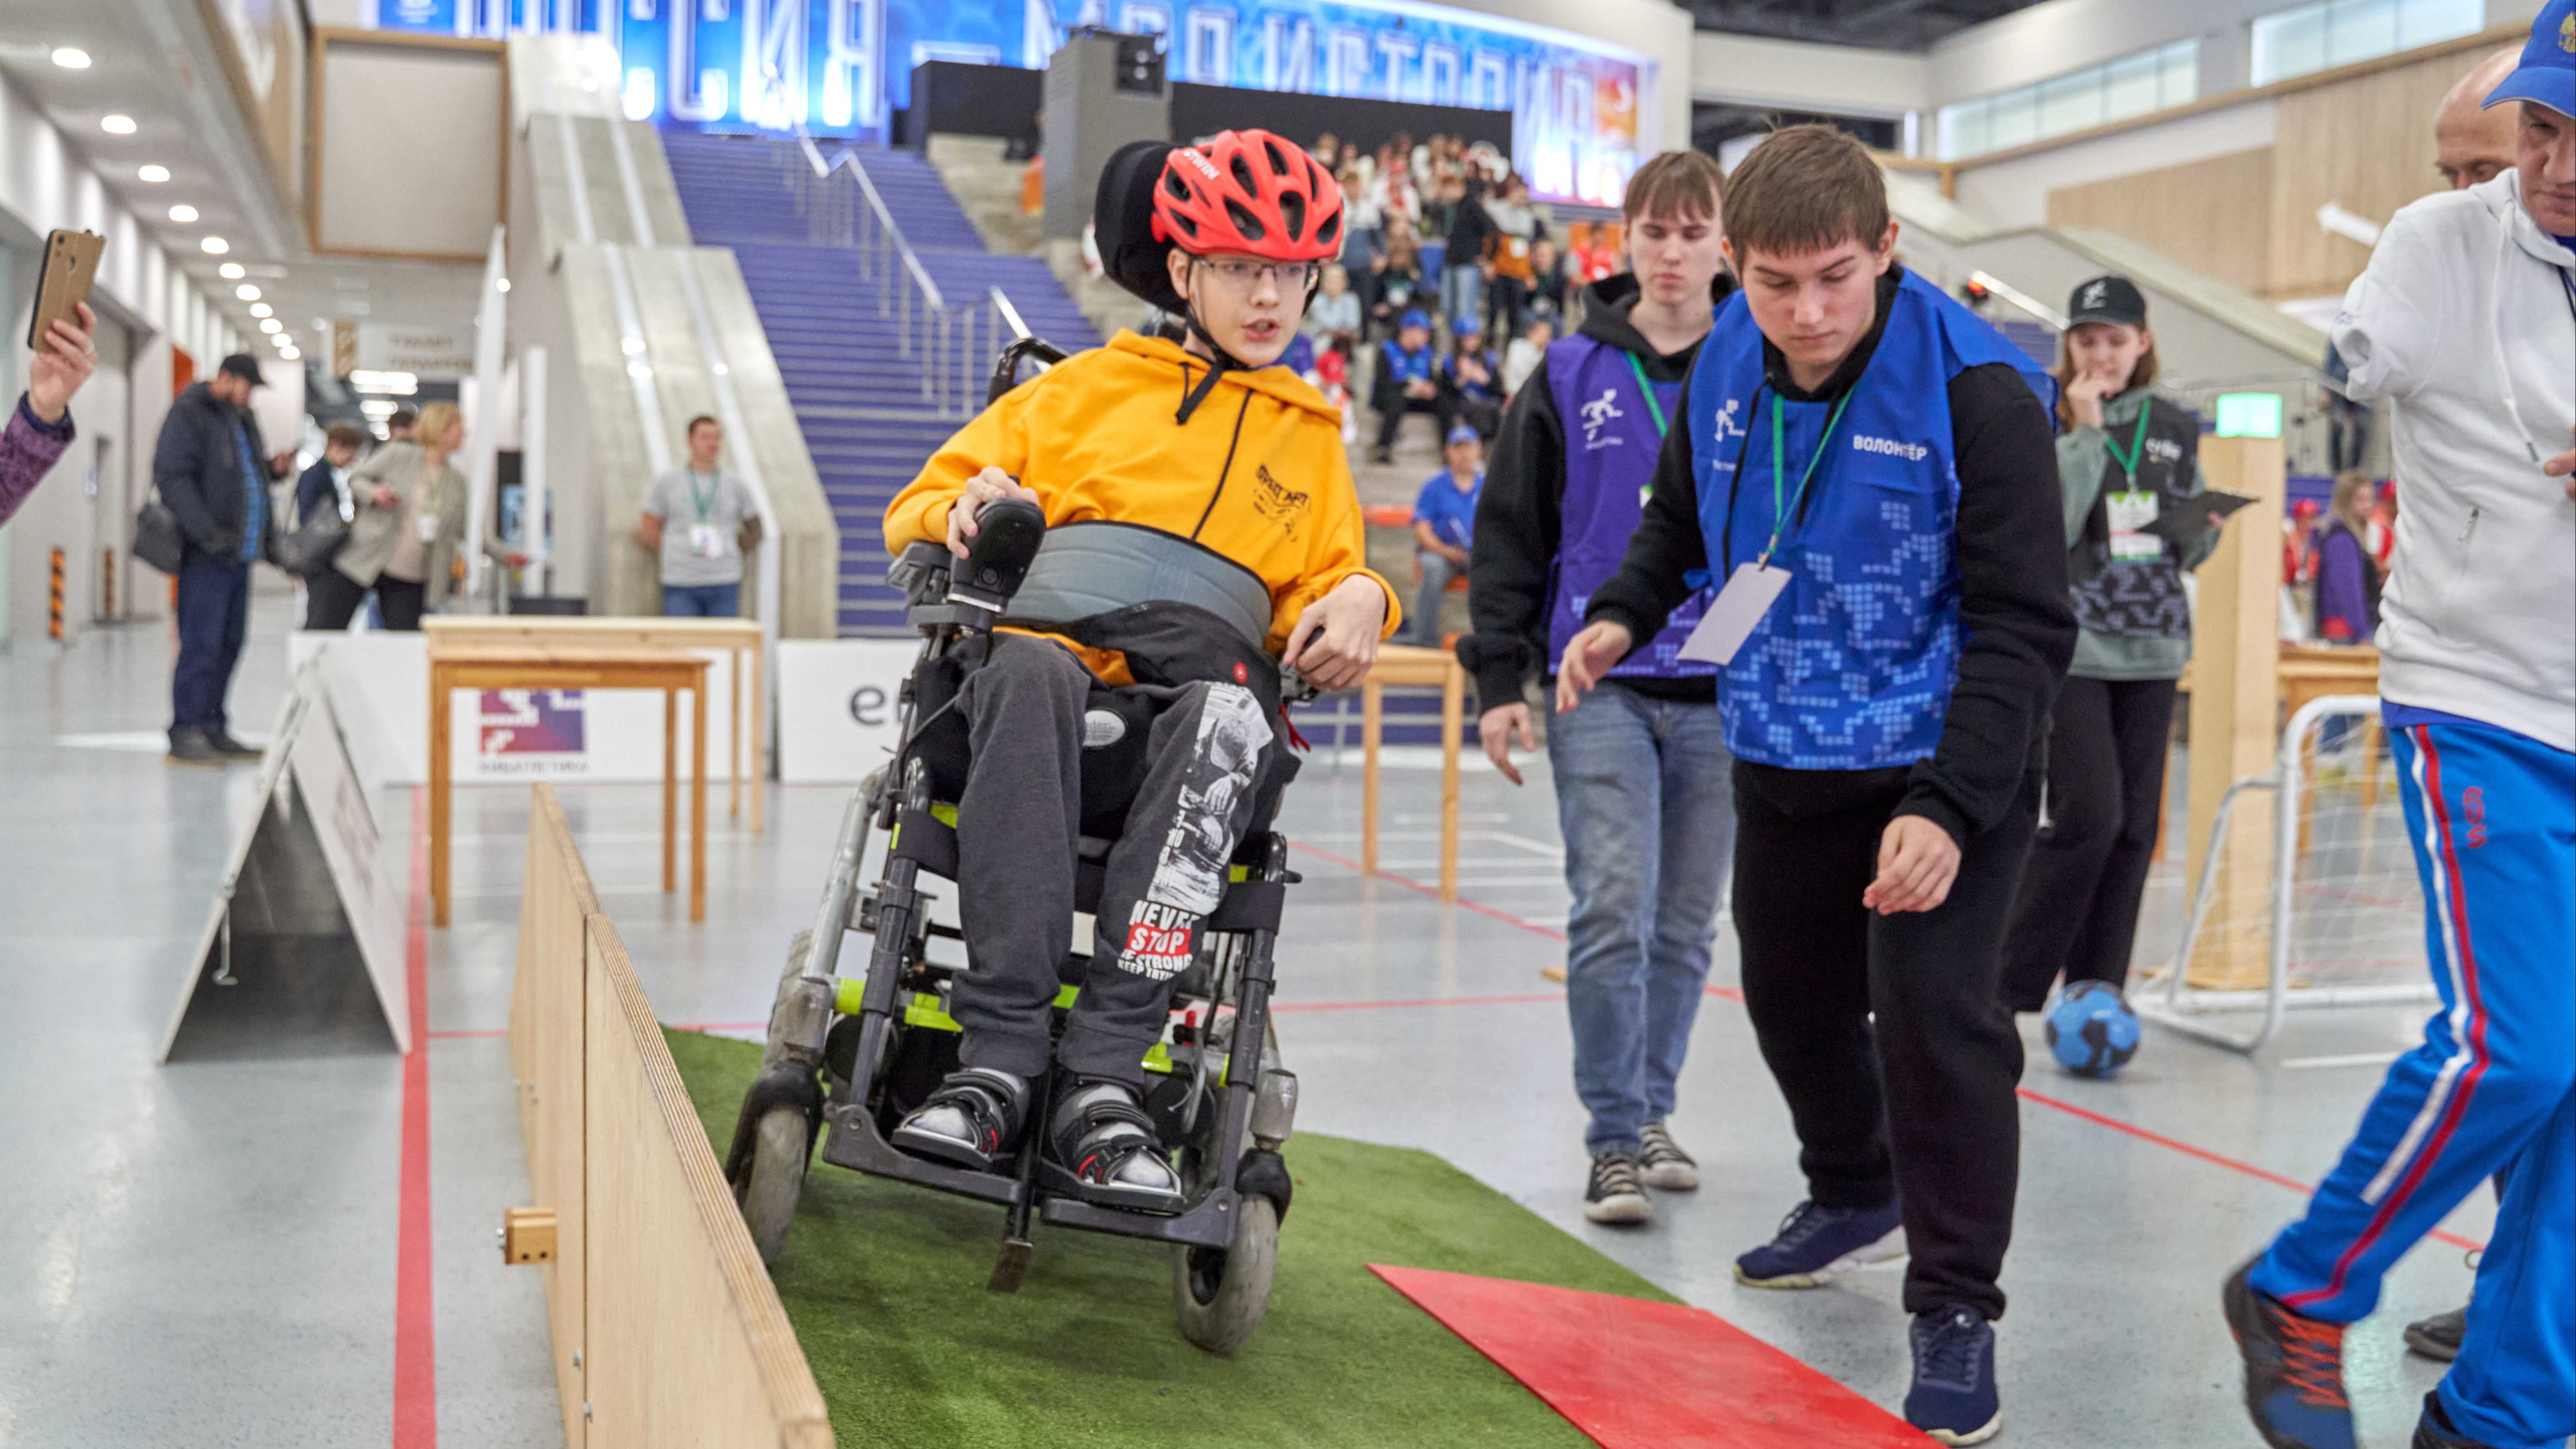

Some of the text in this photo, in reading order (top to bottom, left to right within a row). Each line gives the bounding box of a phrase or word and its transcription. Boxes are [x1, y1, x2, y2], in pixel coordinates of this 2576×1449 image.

[2463, 786, 2488, 849] RUS
[1130, 927, 1185, 954] STOP
[1117, 958, 1175, 981] KEEP TRYI
